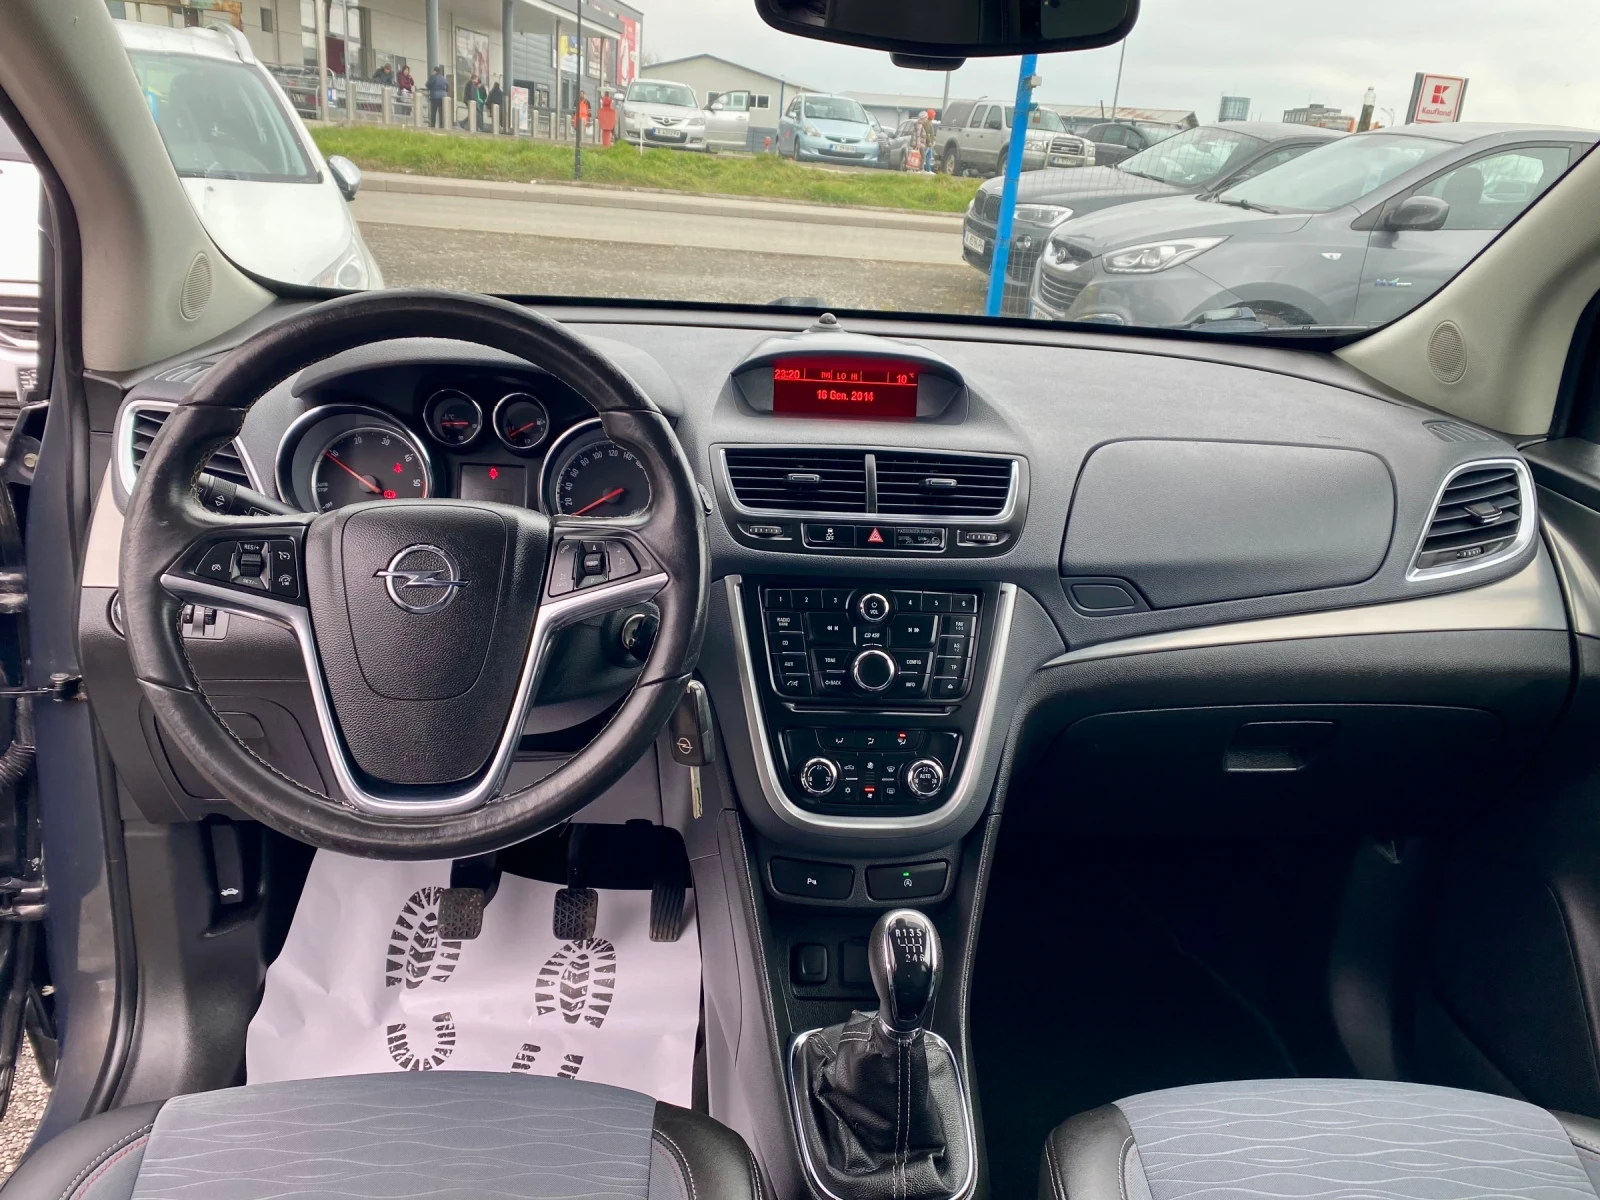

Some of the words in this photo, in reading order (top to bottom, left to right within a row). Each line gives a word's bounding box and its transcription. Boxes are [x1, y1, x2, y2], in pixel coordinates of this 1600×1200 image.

[1422, 107, 1452, 116] Kaufland
[774, 368, 800, 380] 23:20
[896, 374, 908, 384] 10
[816, 390, 827, 400] 16
[851, 391, 874, 402] 2014
[382, 437, 390, 446] 30
[592, 451, 602, 460] 100
[623, 451, 633, 461] 140
[580, 457, 590, 466] 80
[570, 468, 579, 478] 60
[565, 482, 573, 491] 40
[565, 497, 572, 506] 20
